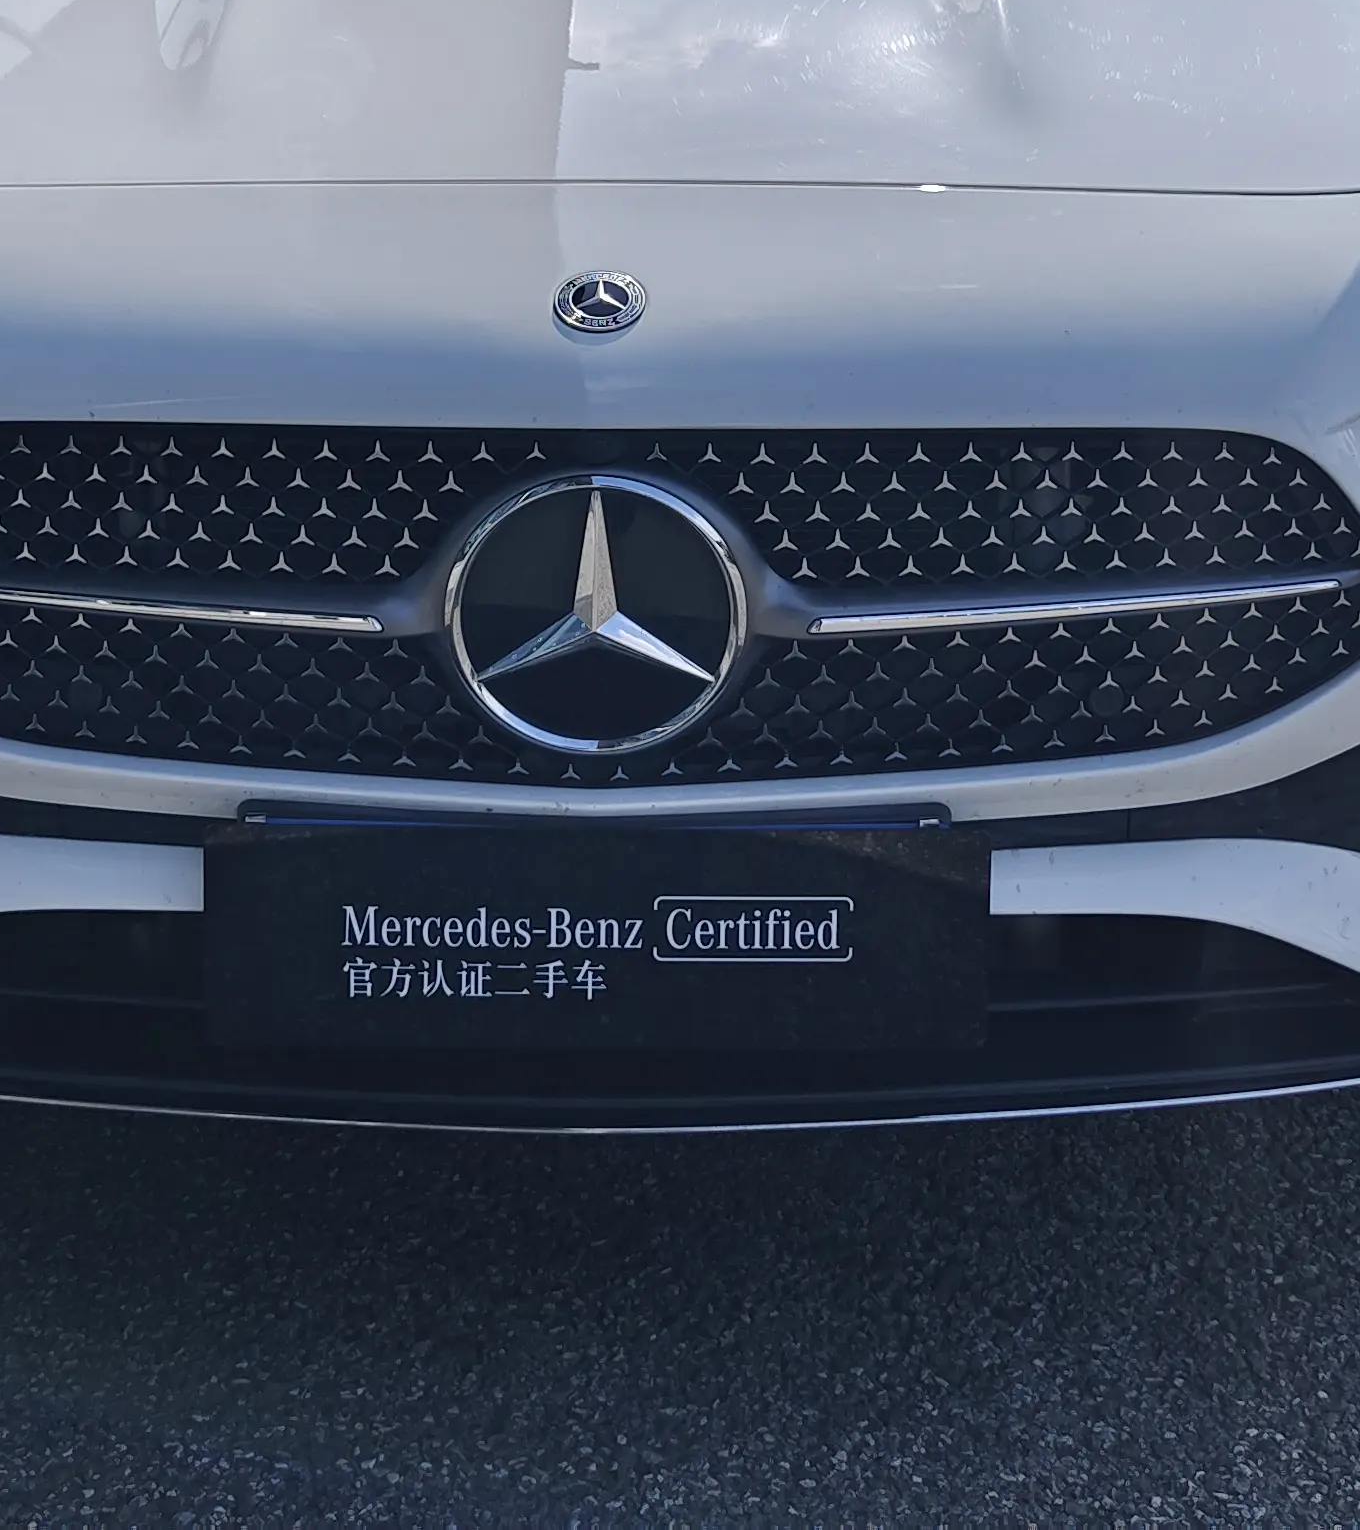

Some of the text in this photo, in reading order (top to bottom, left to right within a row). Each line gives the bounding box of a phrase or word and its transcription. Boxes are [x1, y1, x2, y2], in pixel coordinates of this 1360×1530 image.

[340, 905, 841, 951] Mercedes-Benz Certified
[342, 958, 609, 1001] 官方认证二手车
